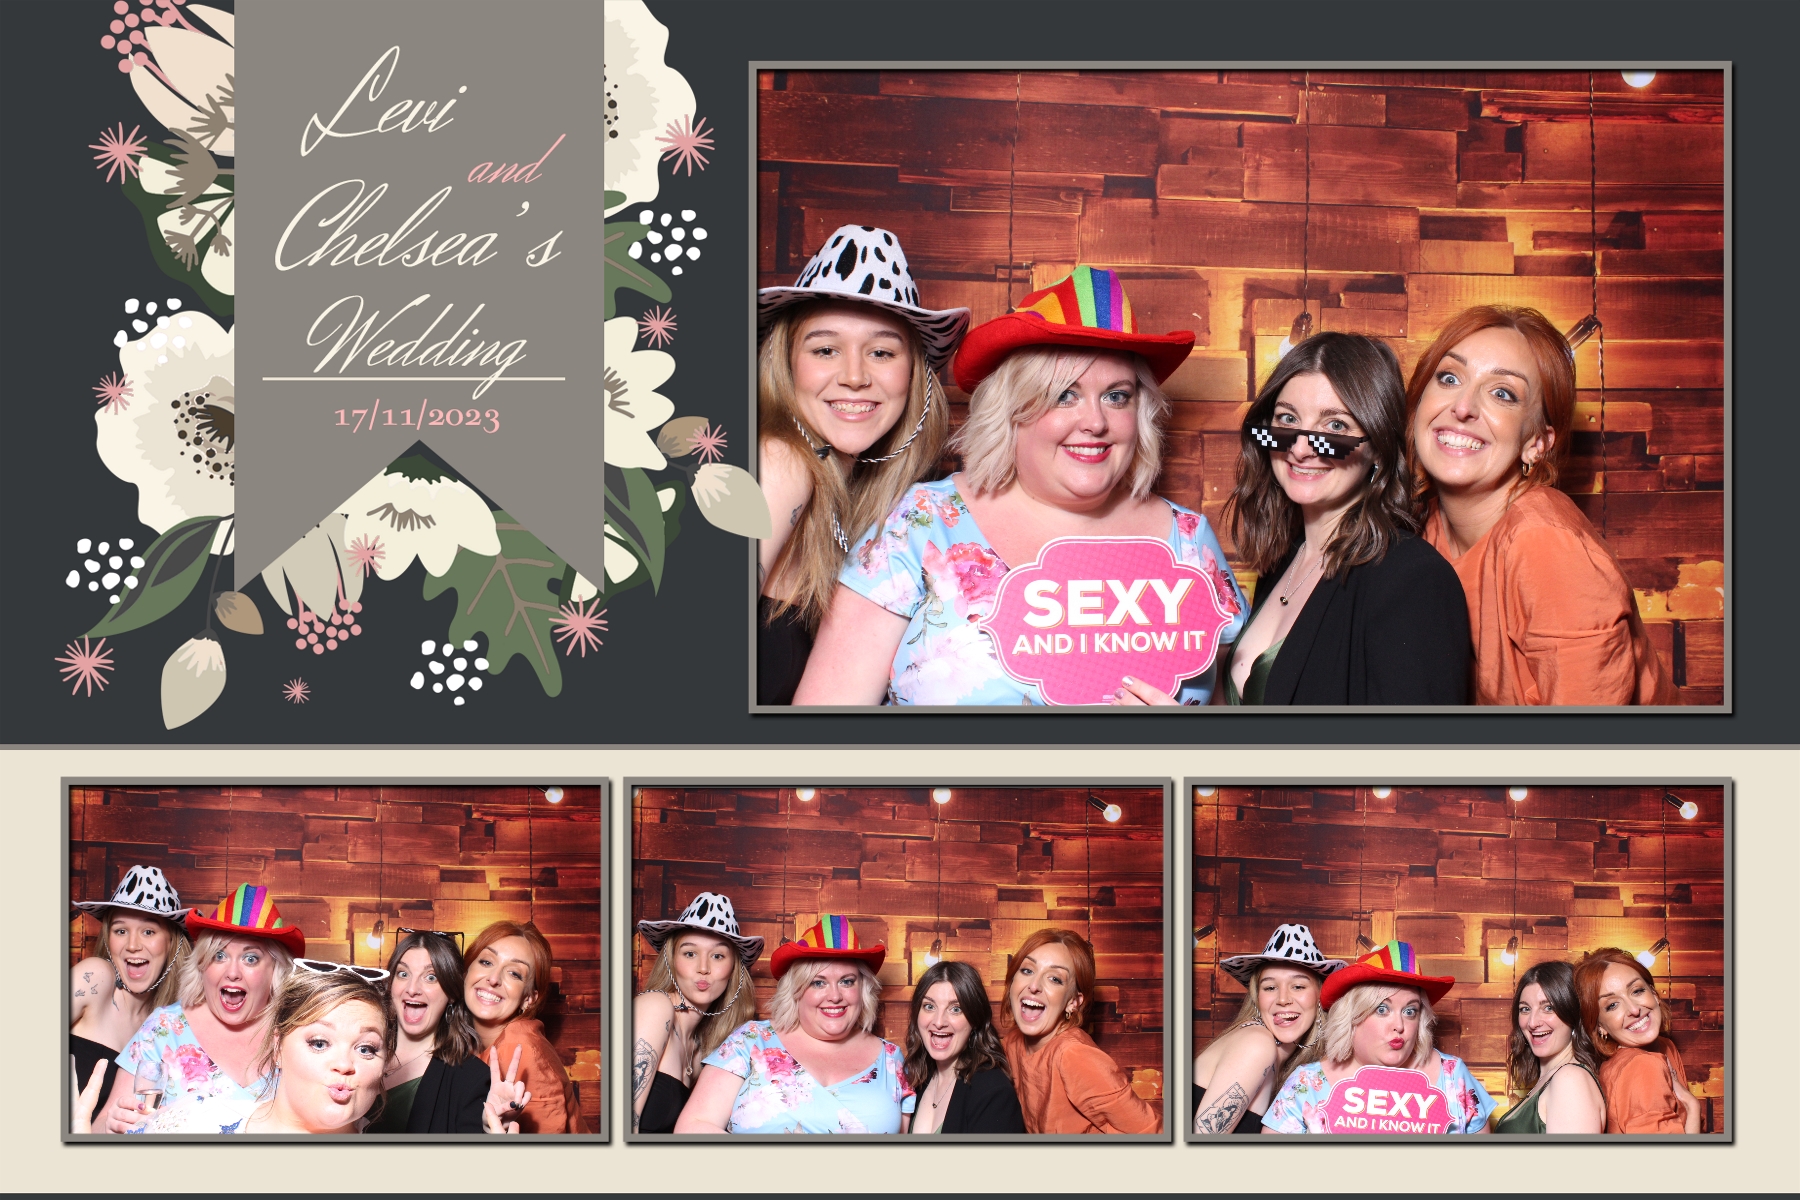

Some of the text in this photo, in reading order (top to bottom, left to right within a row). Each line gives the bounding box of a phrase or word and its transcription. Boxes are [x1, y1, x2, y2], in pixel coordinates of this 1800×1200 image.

[1023, 579, 1195, 628] SEXY
[1012, 630, 1206, 656] AND I KNOW IT
[1343, 1087, 1437, 1118] SEXY
[1334, 1115, 1441, 1134] AND I KNOW IT
